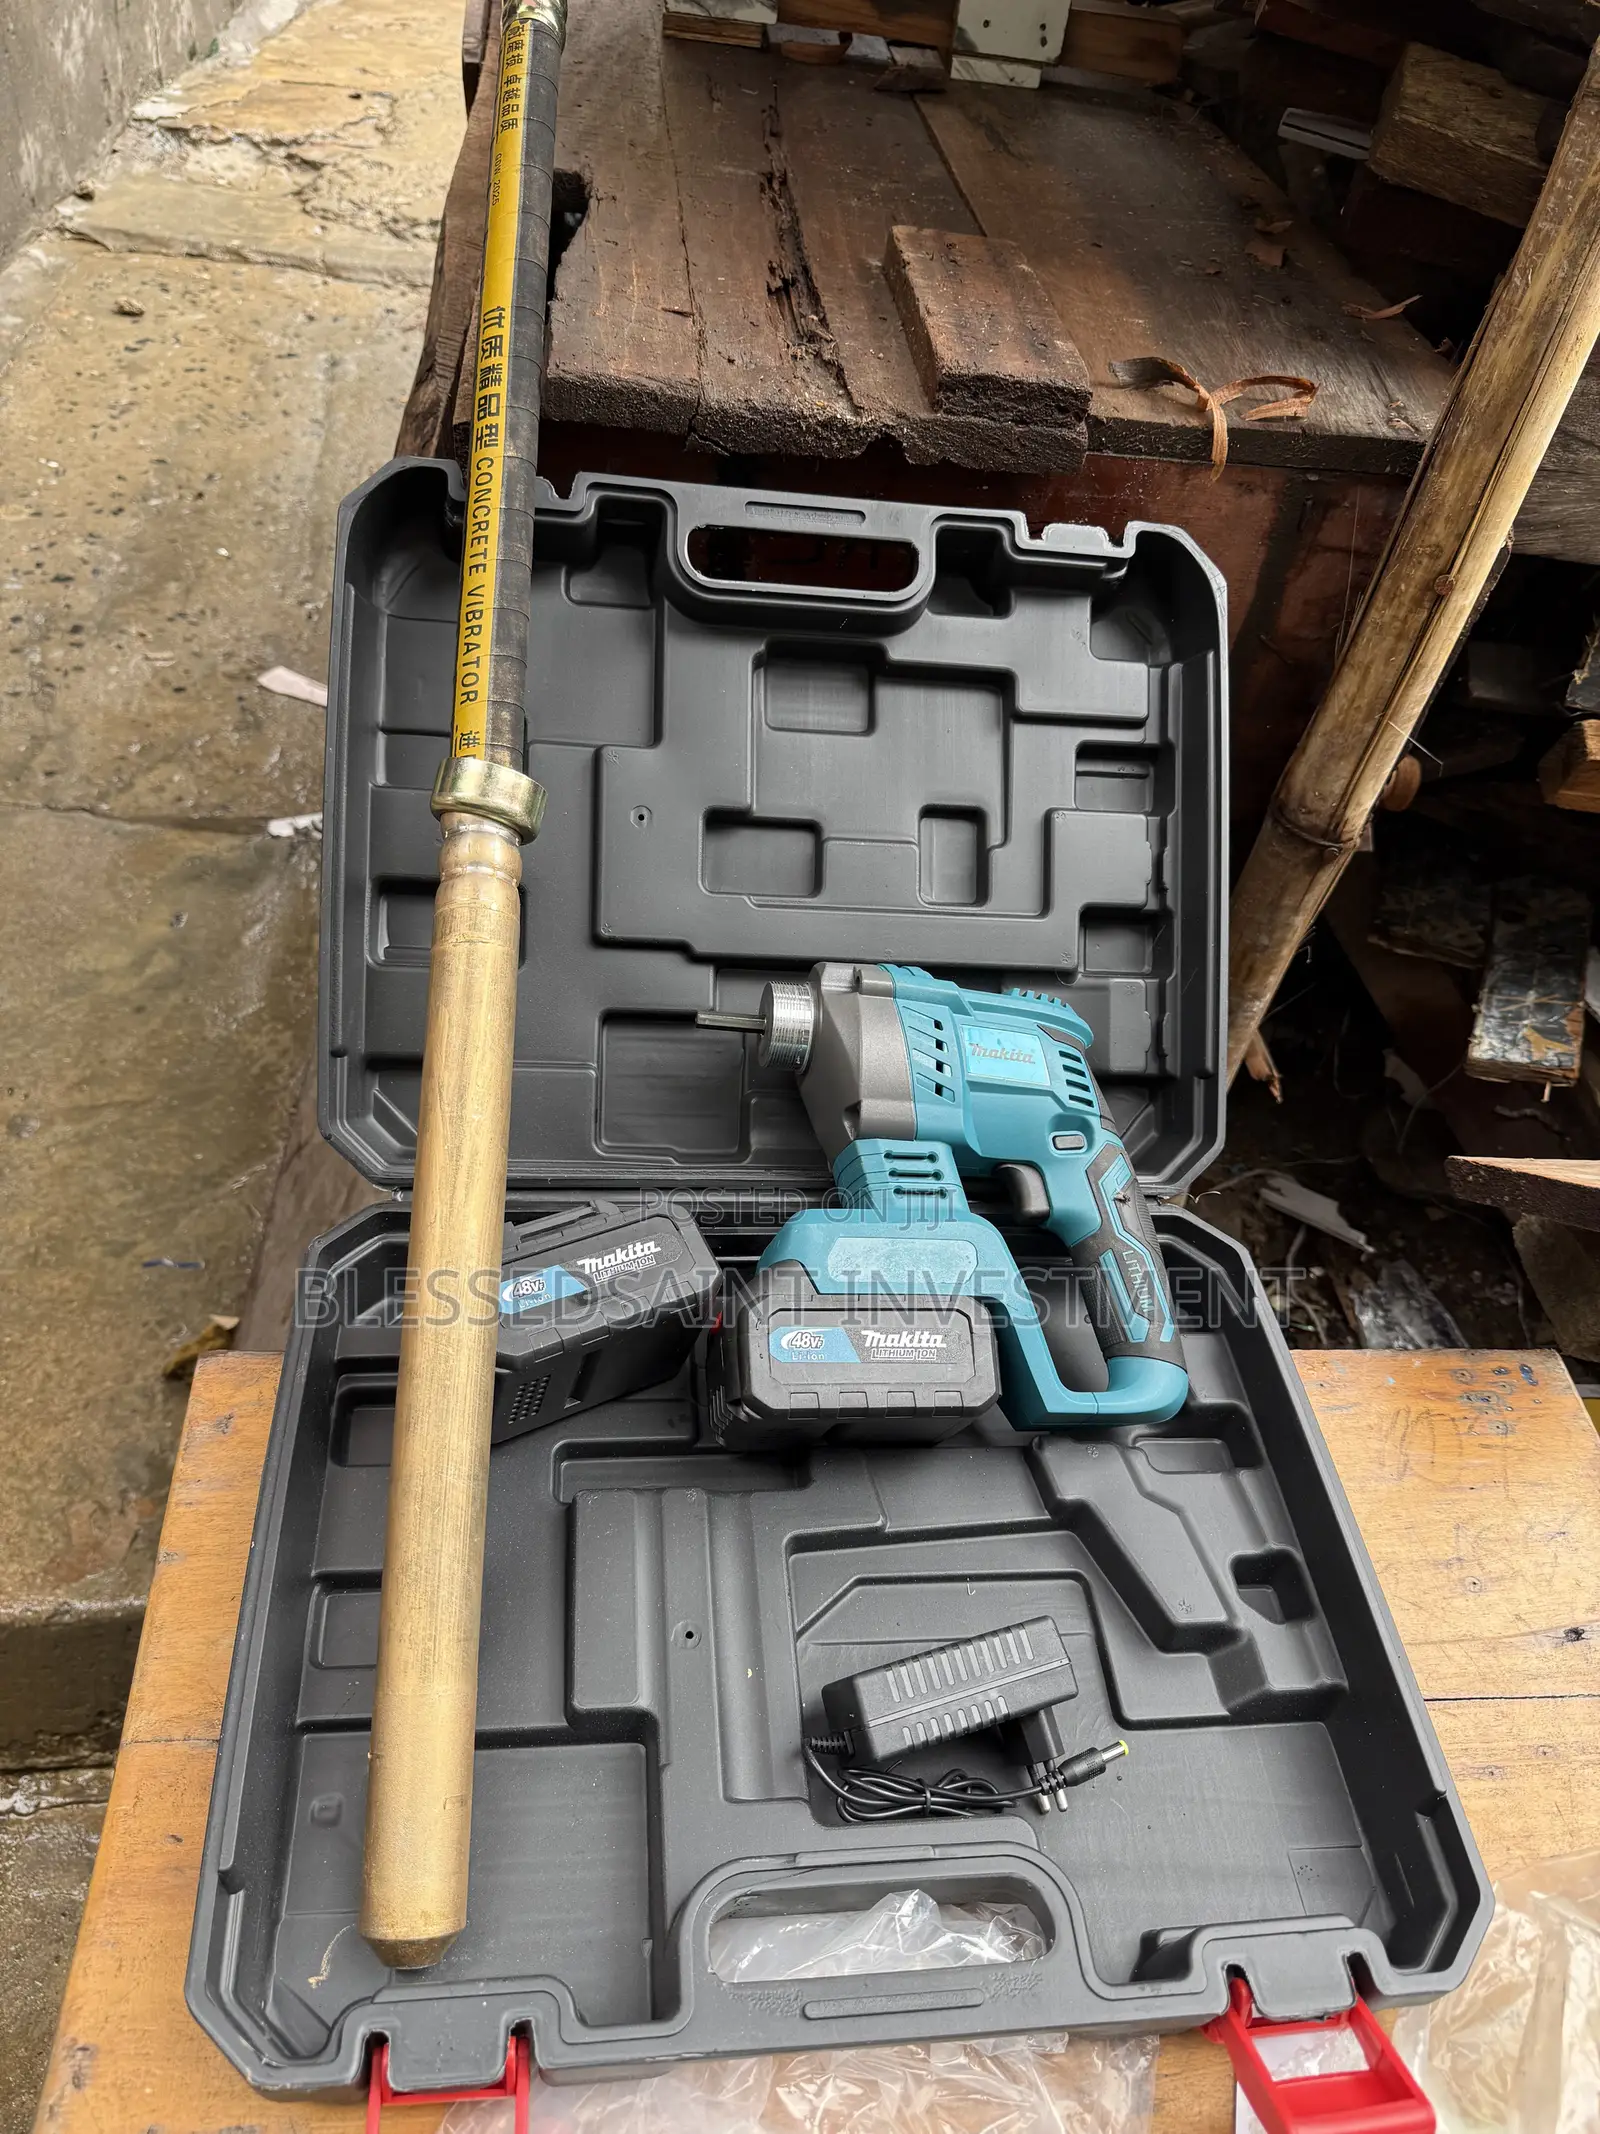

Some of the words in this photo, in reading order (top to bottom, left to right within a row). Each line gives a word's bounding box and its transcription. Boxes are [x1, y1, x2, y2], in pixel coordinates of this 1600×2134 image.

[492, 179, 501, 206] 2025
[474, 306, 506, 452] 优质精品型
[468, 456, 494, 577] CONCRETE
[459, 584, 485, 706] VIBRATOR
[1122, 1250, 1155, 1313] LITHIUM
